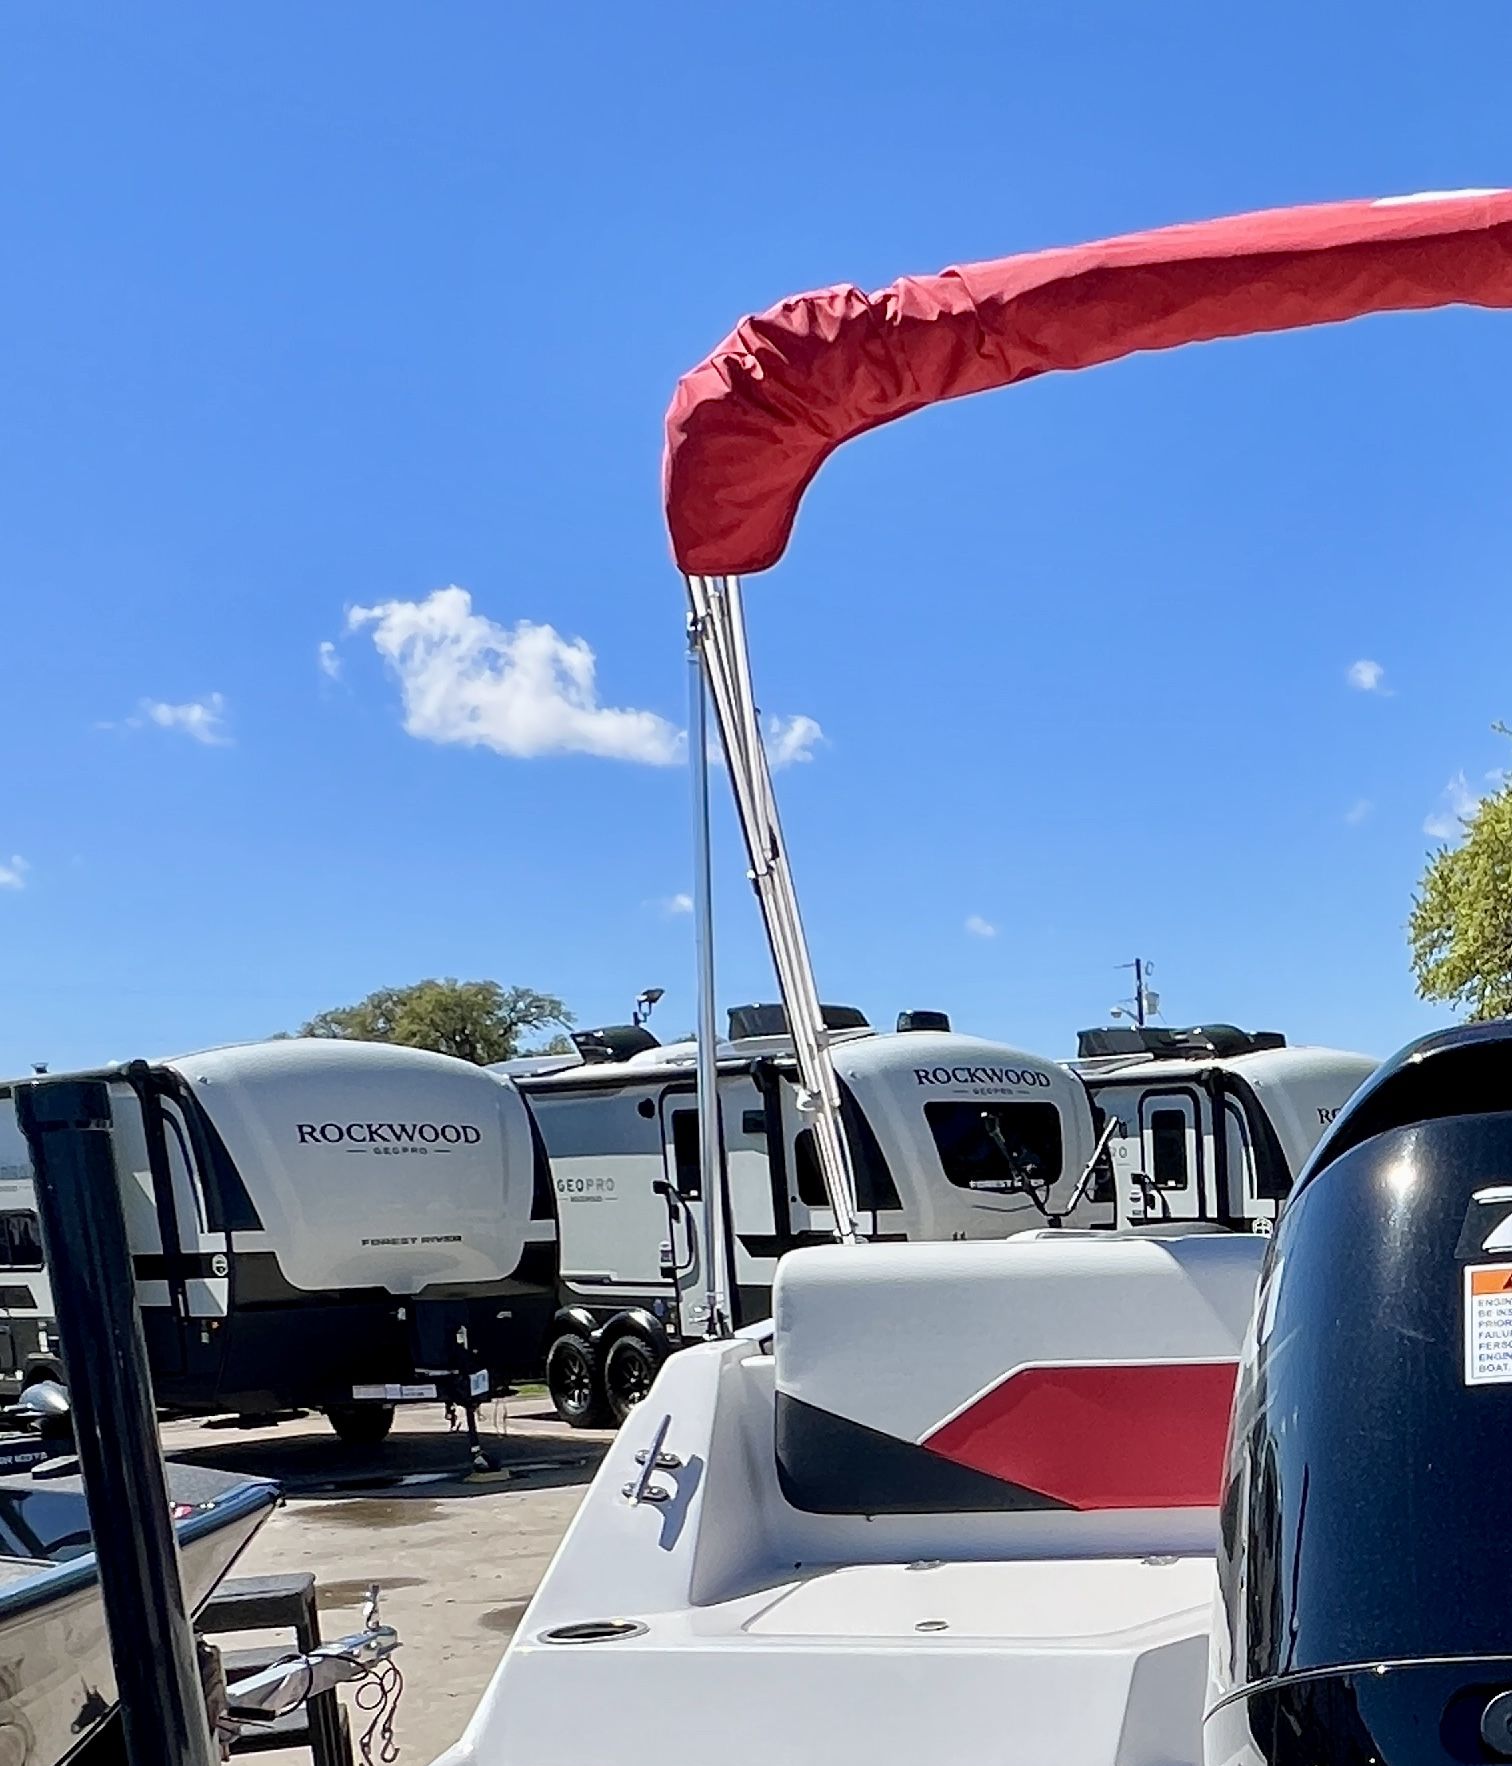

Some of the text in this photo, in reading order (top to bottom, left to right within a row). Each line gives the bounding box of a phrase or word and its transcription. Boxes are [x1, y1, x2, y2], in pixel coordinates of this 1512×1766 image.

[913, 1067, 1051, 1087] ROCKWOOD
[296, 1123, 481, 1144] ROCKWOOD
[556, 1178, 615, 1193] GEOPRO
[361, 1235, 462, 1246] FOREST RIVER
[1478, 1309, 1492, 1318] BE
[1478, 1319, 1512, 1328] PRIOR
